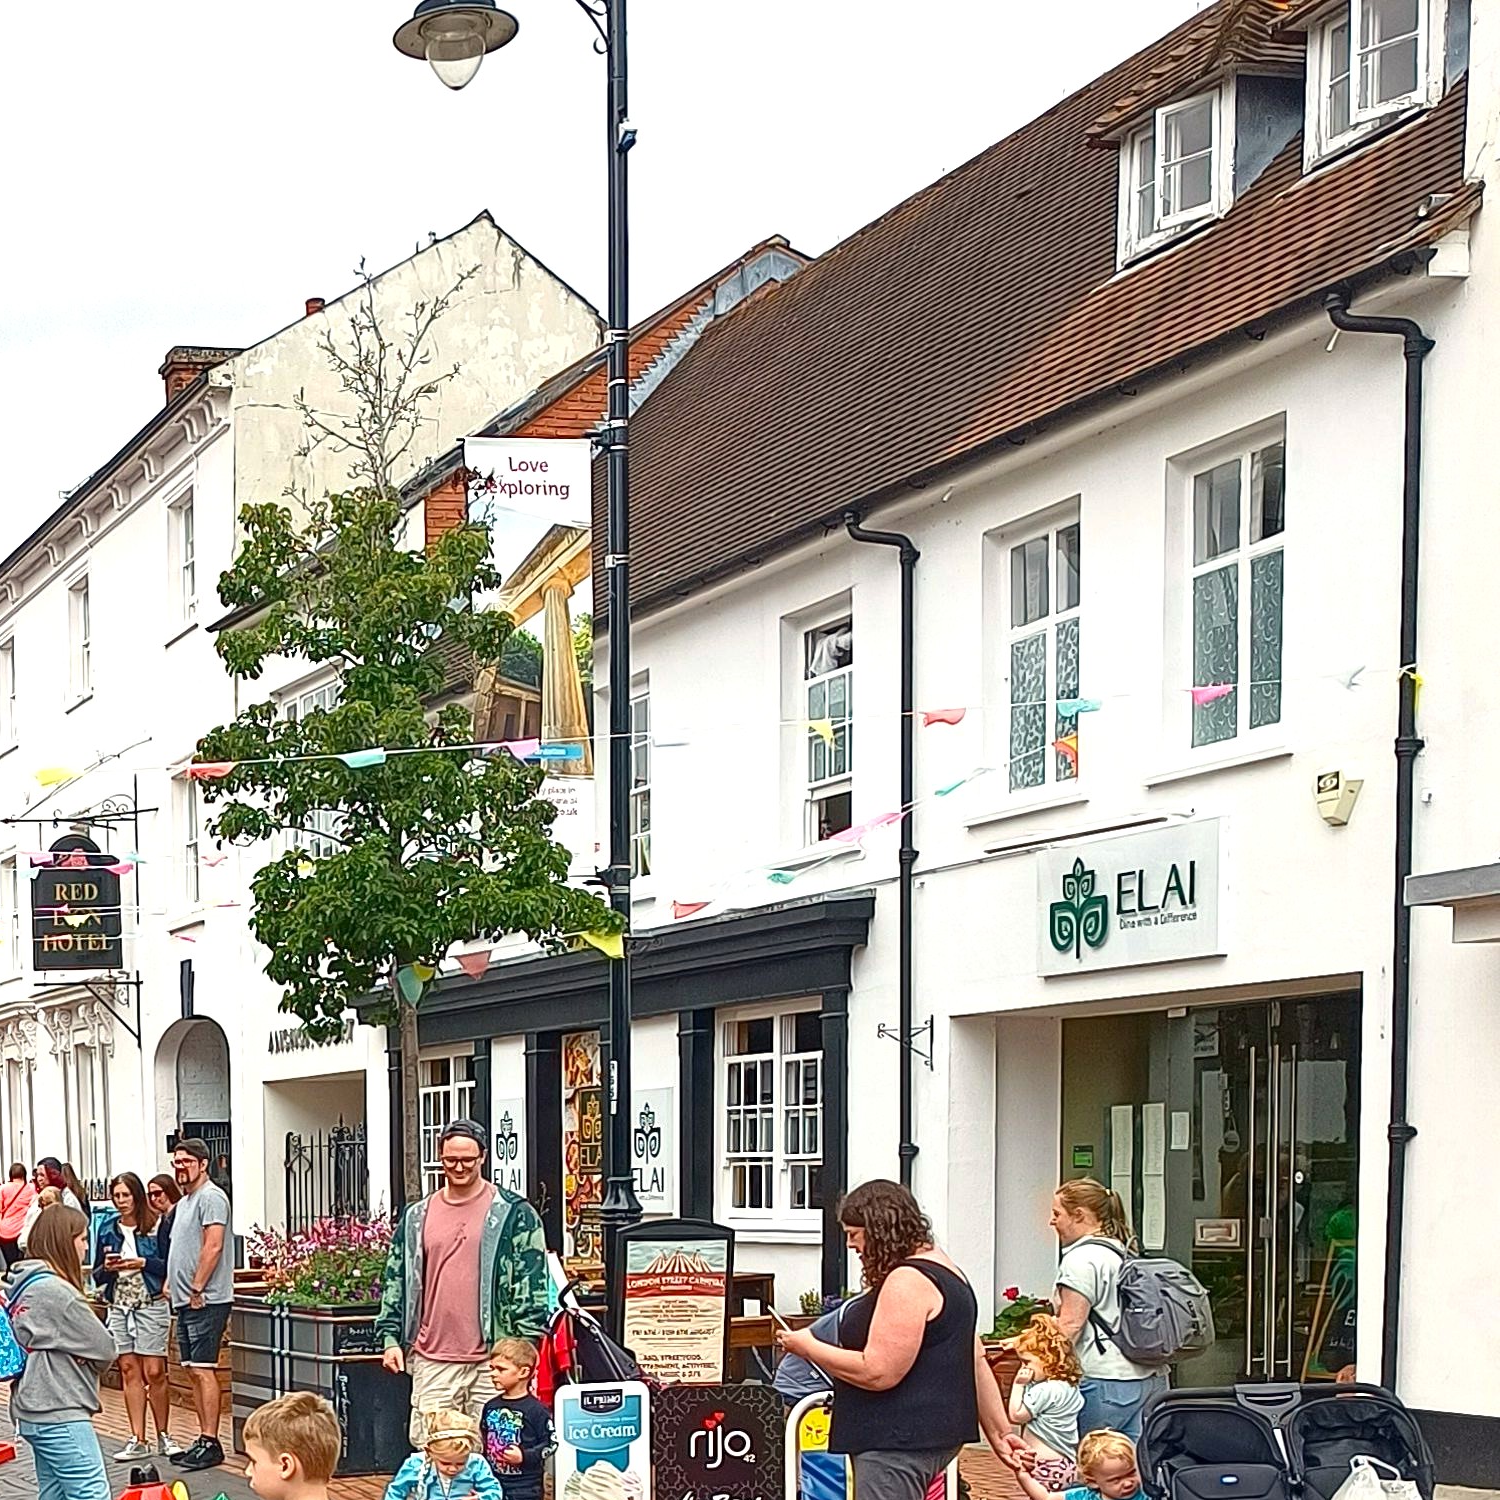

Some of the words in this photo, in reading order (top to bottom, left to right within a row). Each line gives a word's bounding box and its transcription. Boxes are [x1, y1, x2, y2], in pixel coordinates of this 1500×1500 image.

[508, 456, 549, 473] Love
[490, 480, 570, 500] exploring
[54, 883, 99, 901] RED
[1116, 860, 1196, 915] ELAI
[52, 908, 102, 926] LN
[43, 932, 114, 952] HOTEL
[581, 1146, 603, 1167] ELA
[631, 1167, 664, 1192] ELAI
[583, 1396, 592, 1405] IL
[568, 1425, 589, 1441] Ice
[591, 1423, 637, 1439] Cream
